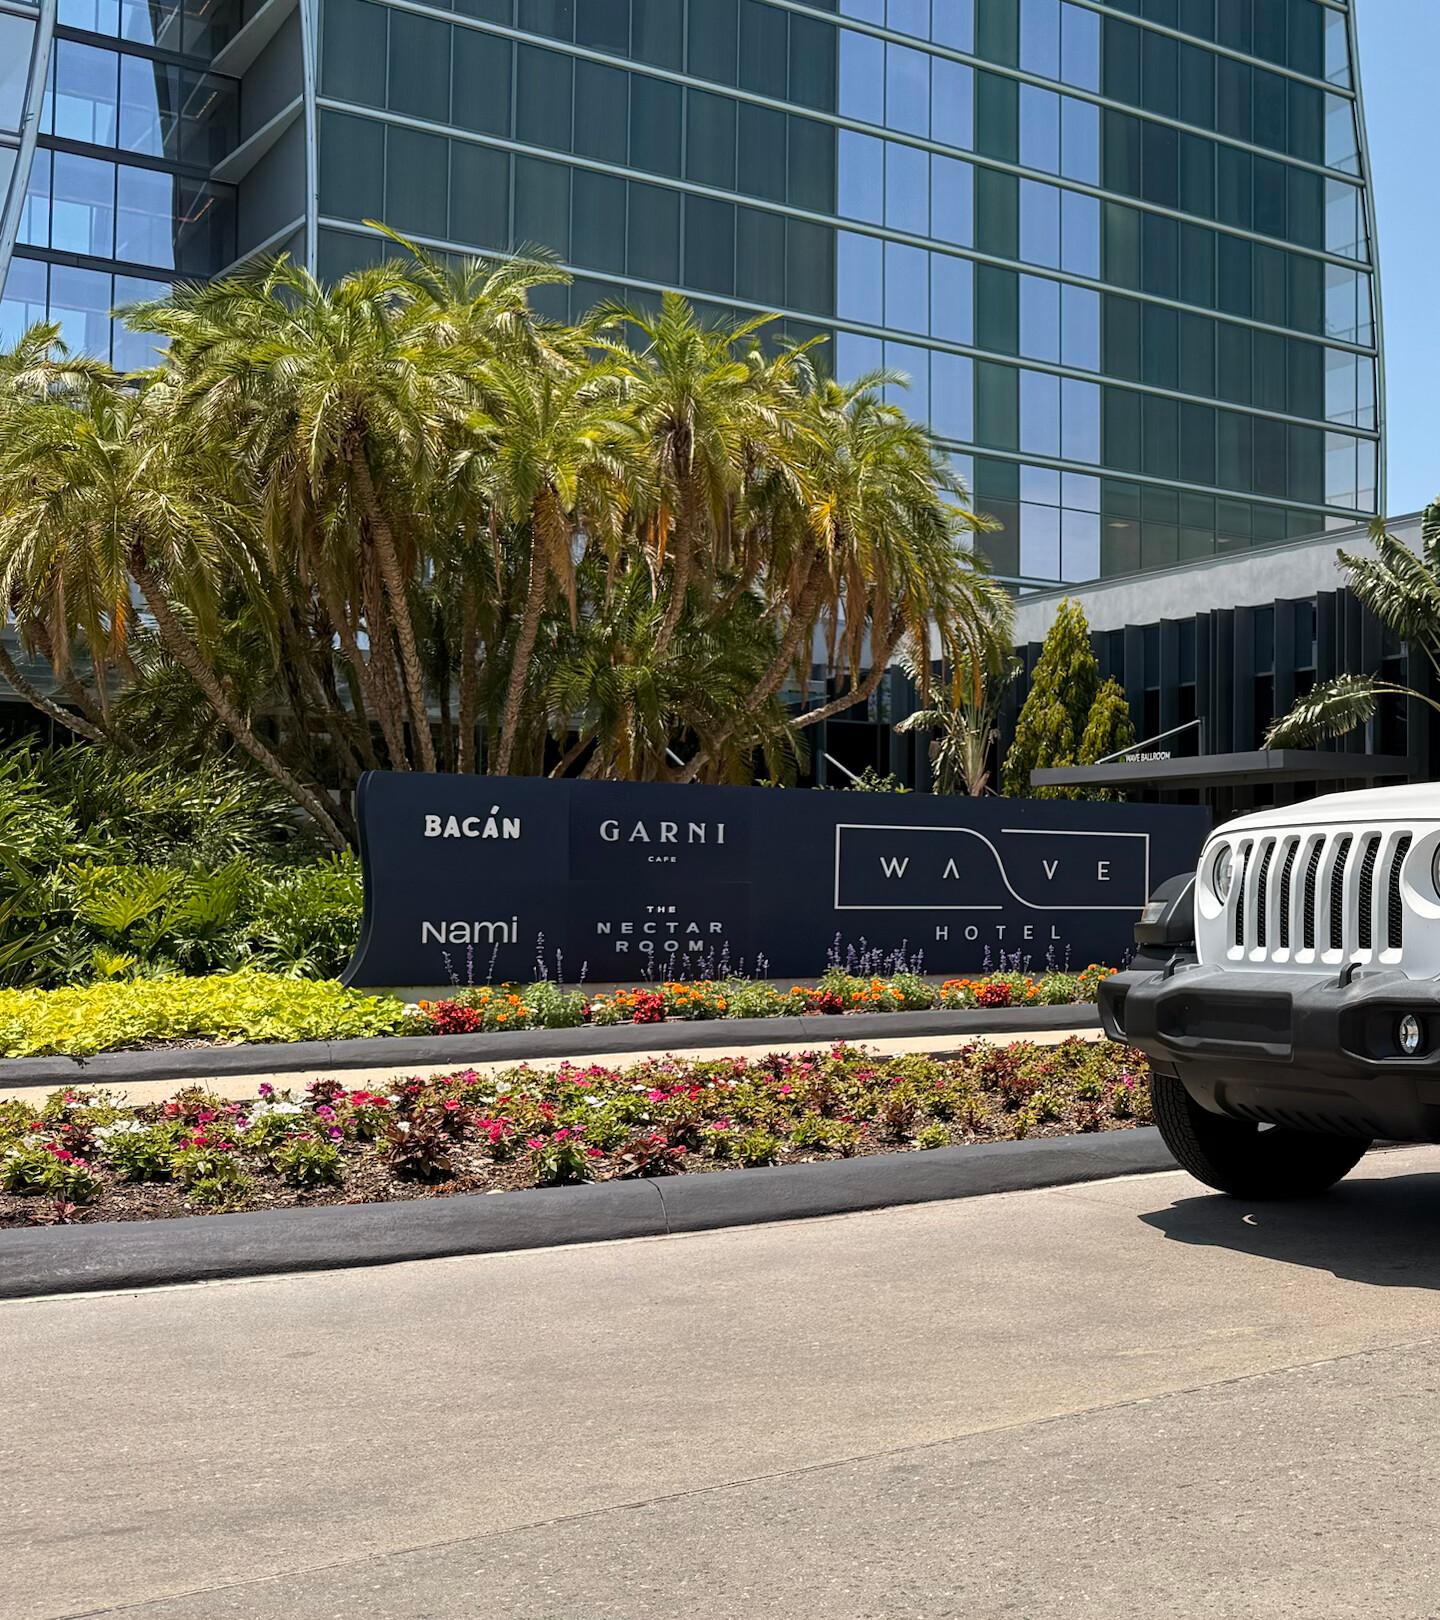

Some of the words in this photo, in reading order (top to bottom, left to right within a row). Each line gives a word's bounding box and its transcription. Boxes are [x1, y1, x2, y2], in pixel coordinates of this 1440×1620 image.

[1126, 753, 1140, 763] WAVE
[1140, 751, 1170, 762] BALLROOM
[423, 804, 521, 839] BACÁN
[599, 819, 726, 844] GARNI
[647, 855, 677, 863] CAFE
[879, 856, 1111, 881] WAVE
[646, 905, 677, 914] THE
[421, 915, 519, 945] Nami
[596, 922, 723, 935] NECTAR
[934, 925, 1062, 941] HOTEL
[615, 940, 704, 953] ROOM
